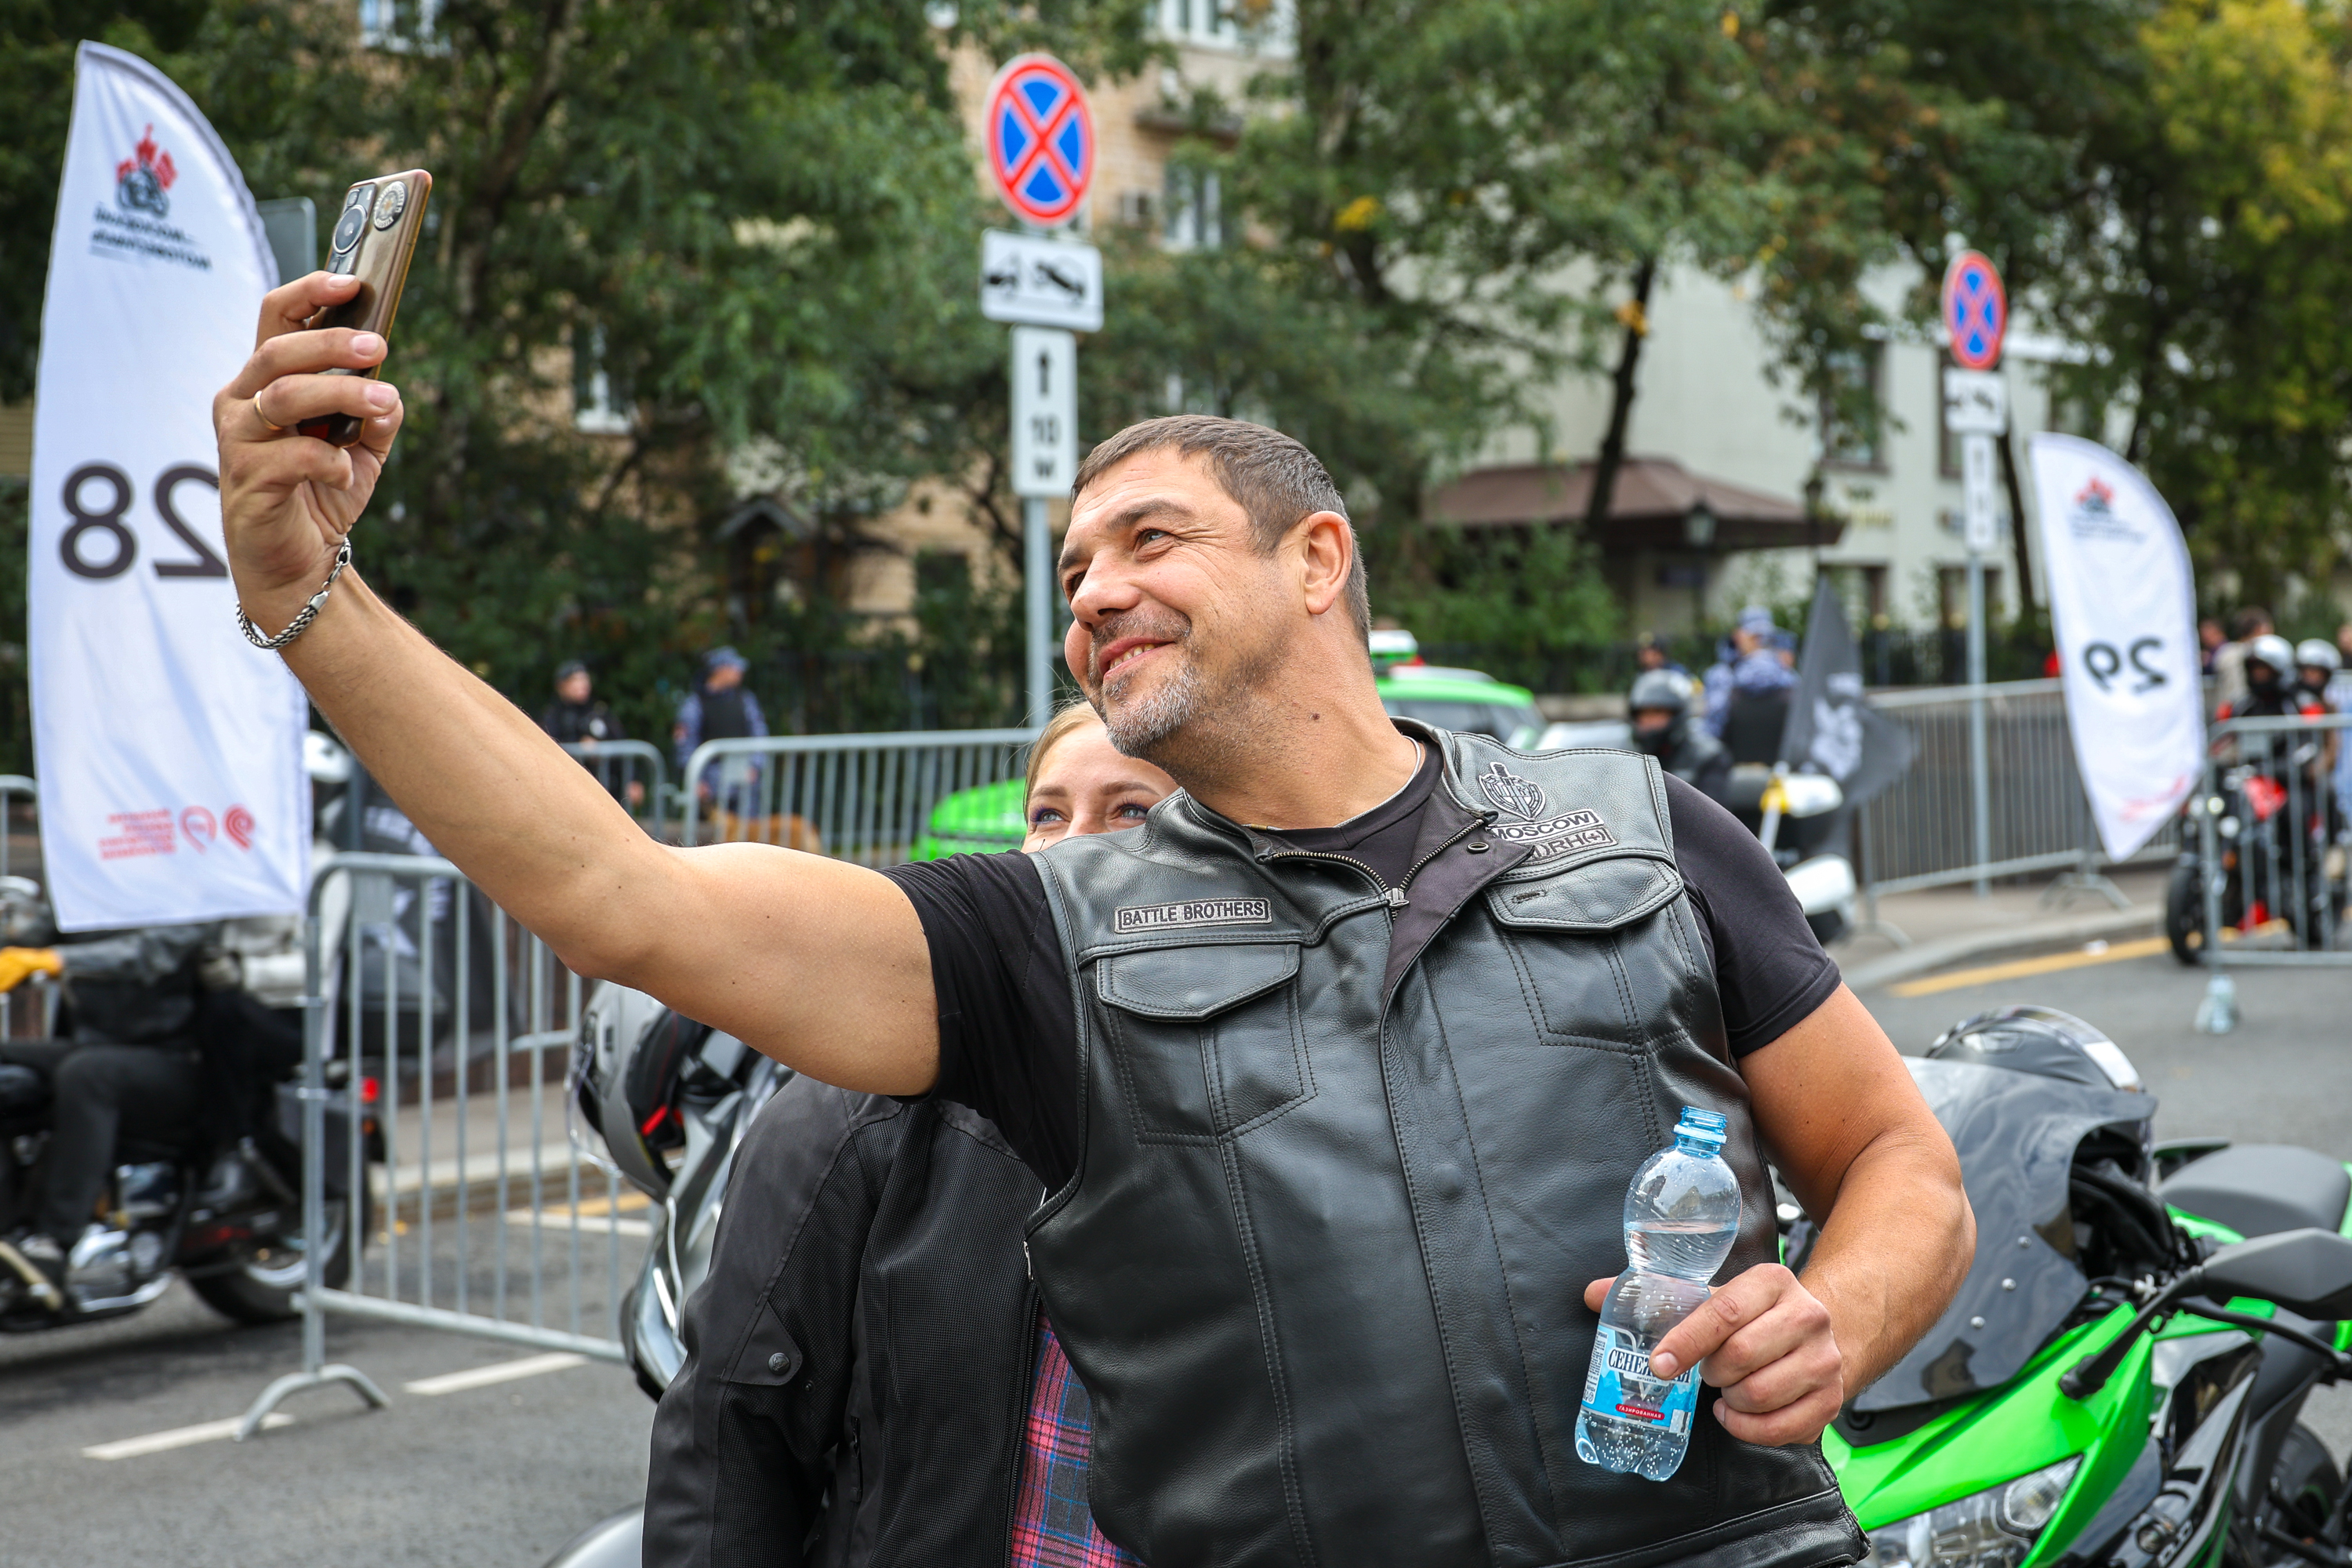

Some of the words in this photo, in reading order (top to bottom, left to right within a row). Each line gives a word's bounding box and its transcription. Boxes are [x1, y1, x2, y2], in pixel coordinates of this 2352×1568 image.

[1122, 907, 1178, 926] BATTLE
[1183, 901, 1265, 920] BROTHERS
[1618, 1406, 1662, 1419] ГАЗИРОВАННАЯ
